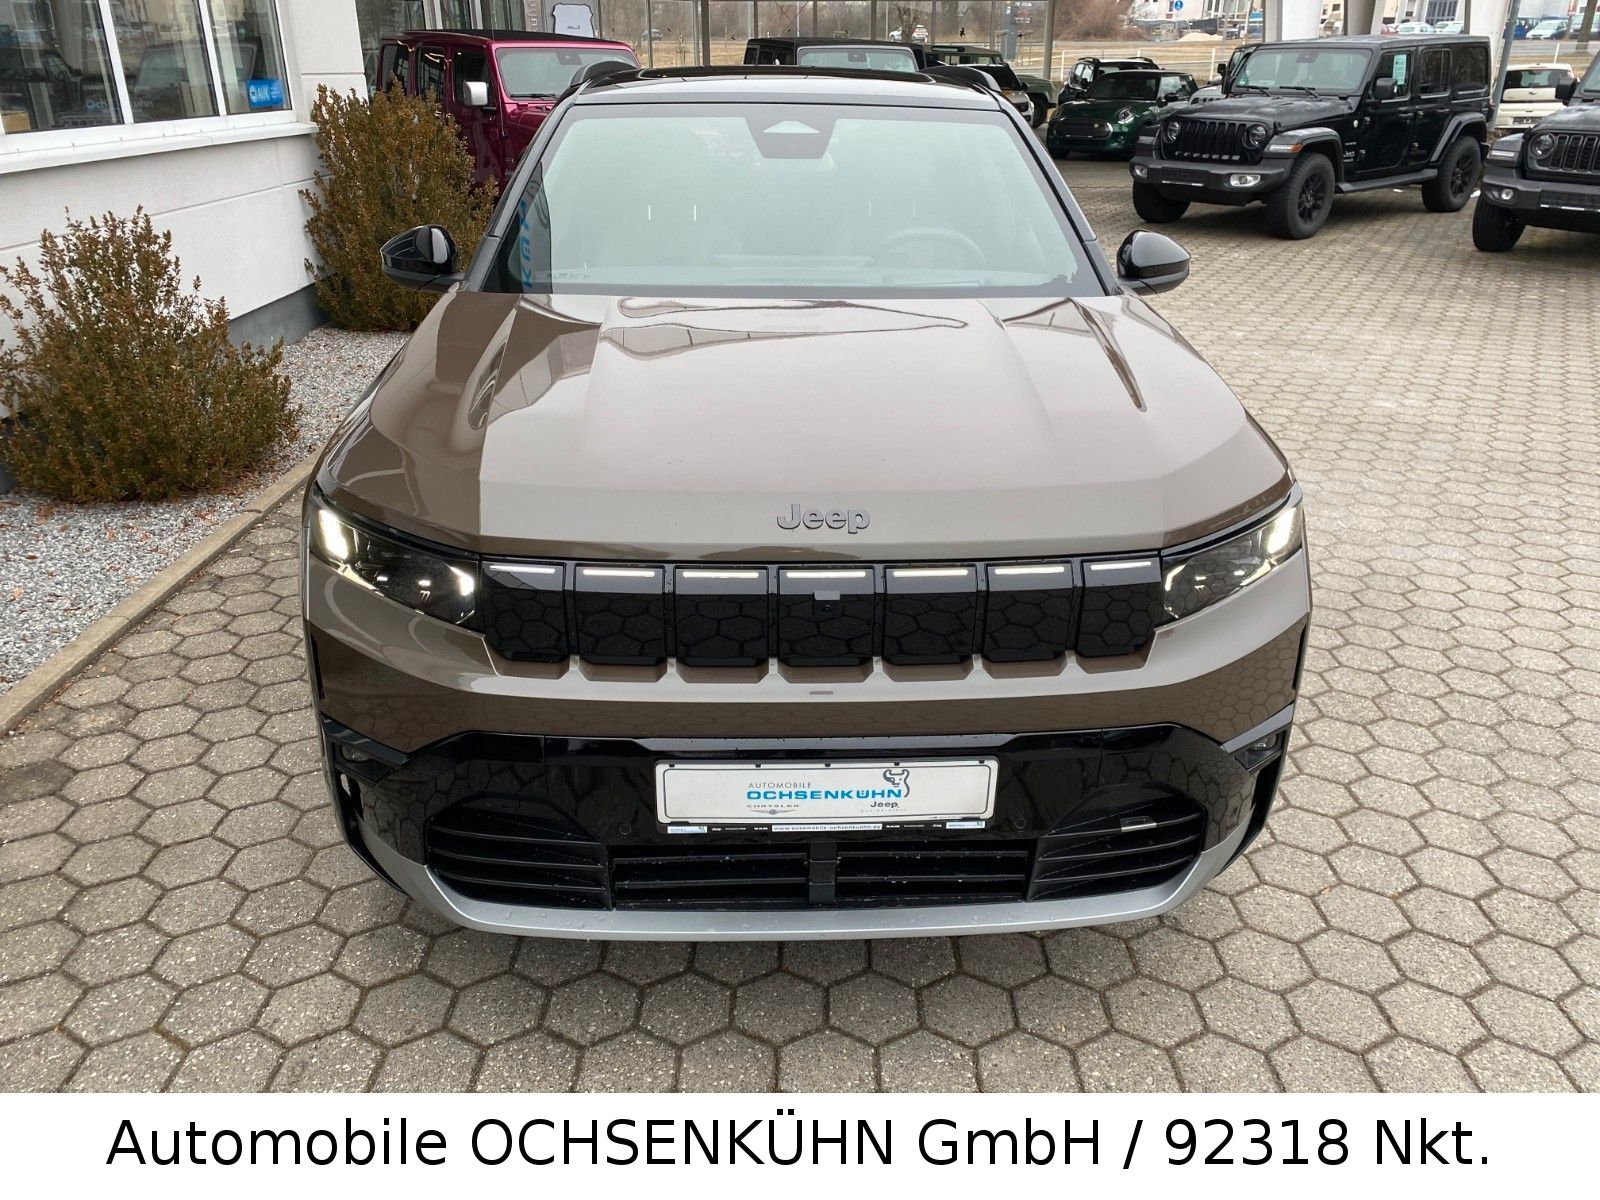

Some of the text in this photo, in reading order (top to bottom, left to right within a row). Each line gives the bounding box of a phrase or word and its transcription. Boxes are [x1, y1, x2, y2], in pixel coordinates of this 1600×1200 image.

[777, 503, 870, 534] Jeep
[748, 781, 812, 789] AUTOMOBILE
[746, 789, 902, 800] OCHSENKÜHN
